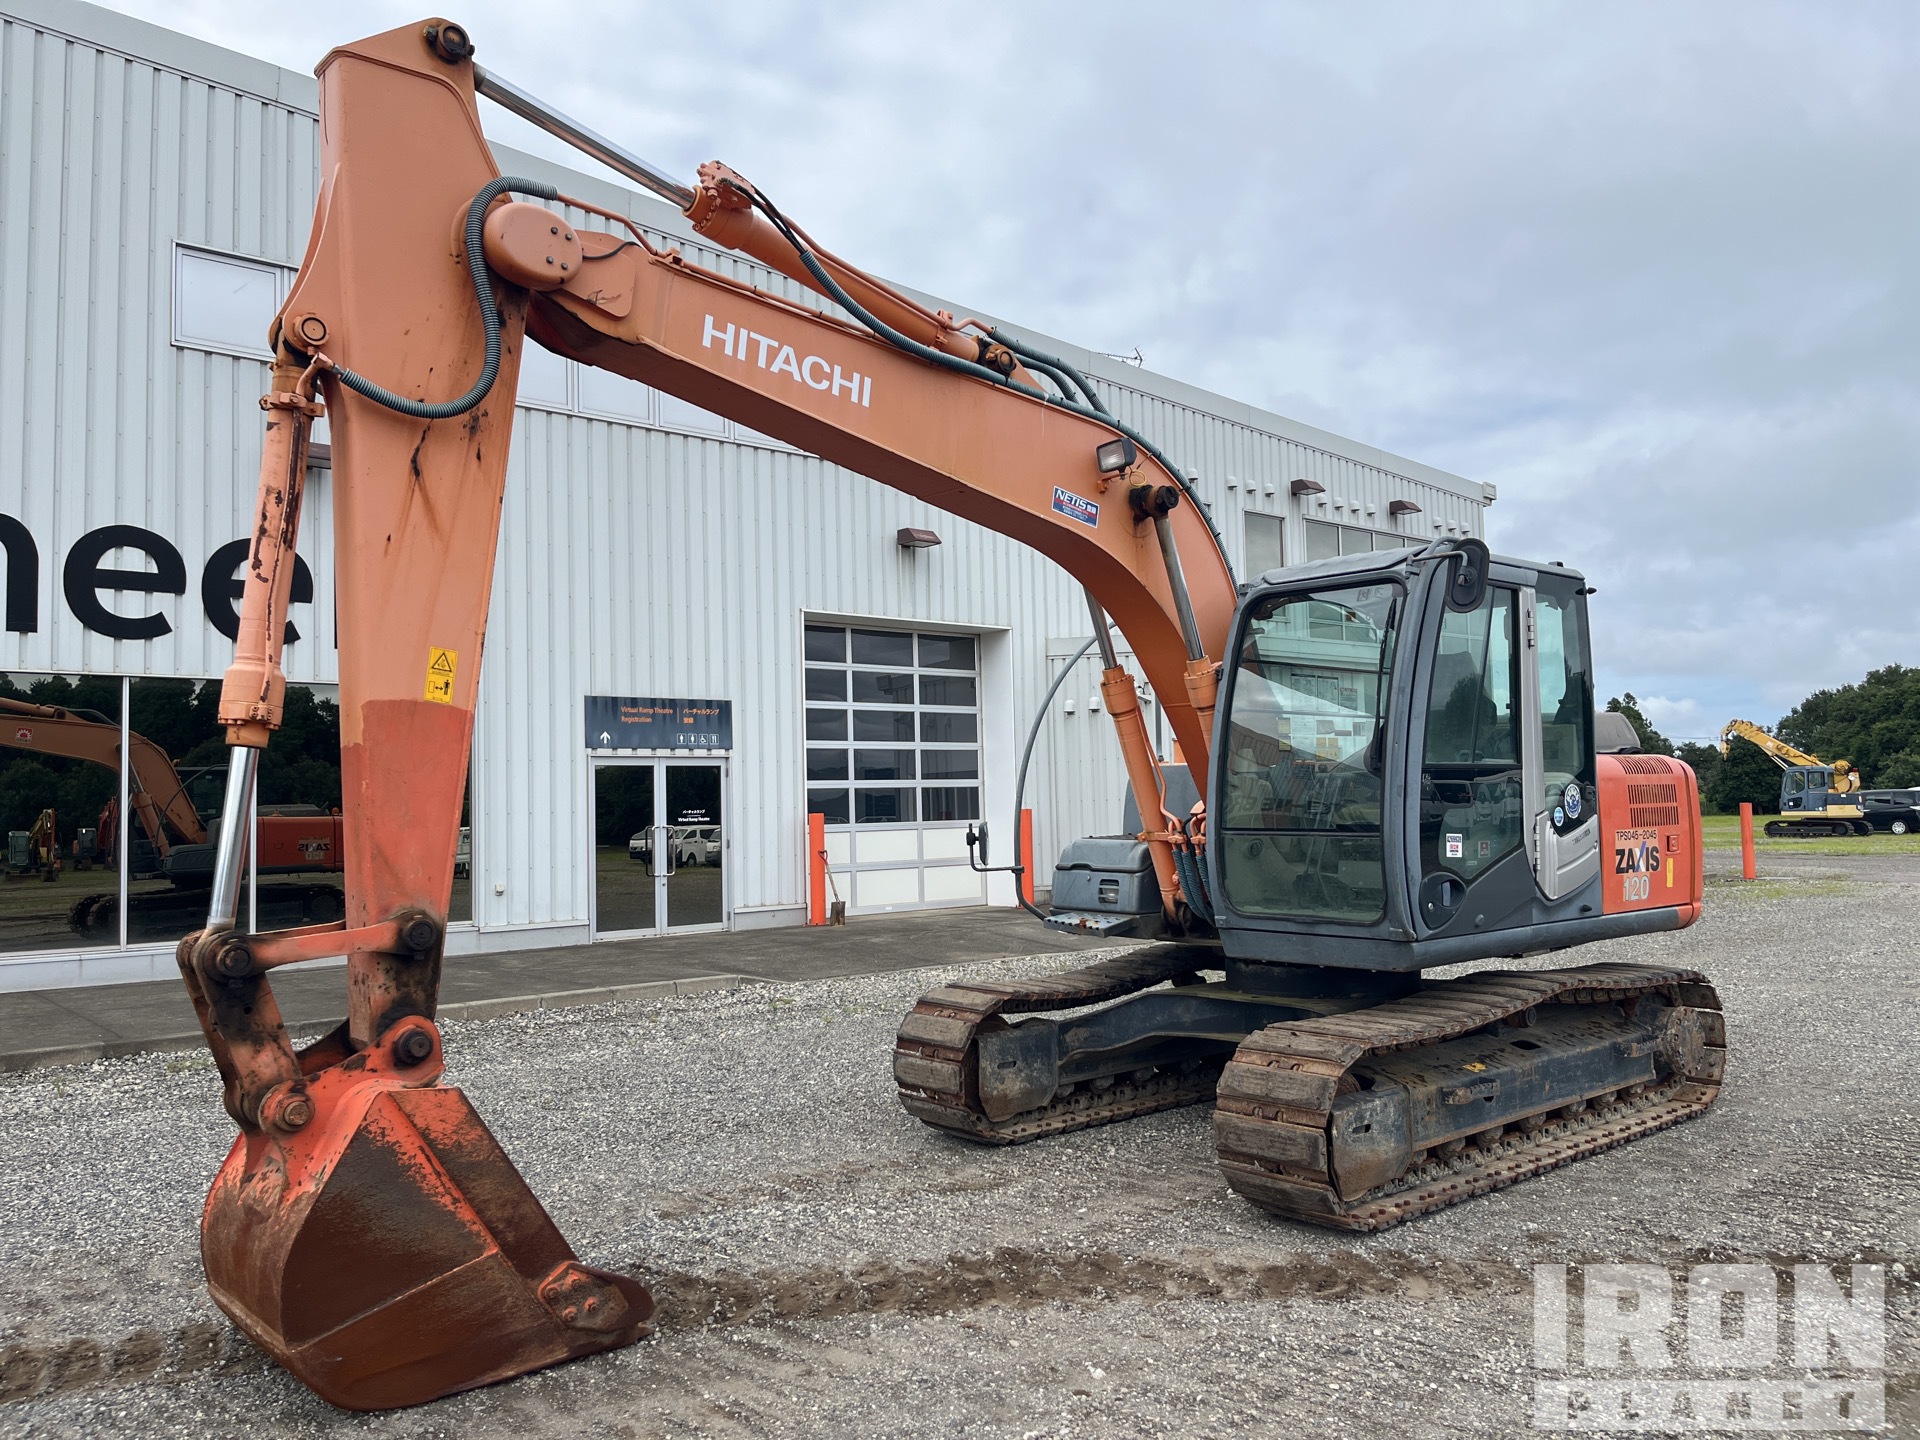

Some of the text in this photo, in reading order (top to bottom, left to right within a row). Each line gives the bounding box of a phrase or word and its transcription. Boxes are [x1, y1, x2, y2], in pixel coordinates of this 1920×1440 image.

[702, 314, 872, 408] HITACHI
[1056, 489, 1088, 510] NETIS
[639, 707, 654, 715] Ramp
[1616, 829, 1657, 841] TPS045-2045
[1615, 840, 1660, 874] ZAXIS
[1623, 875, 1650, 901] 120
